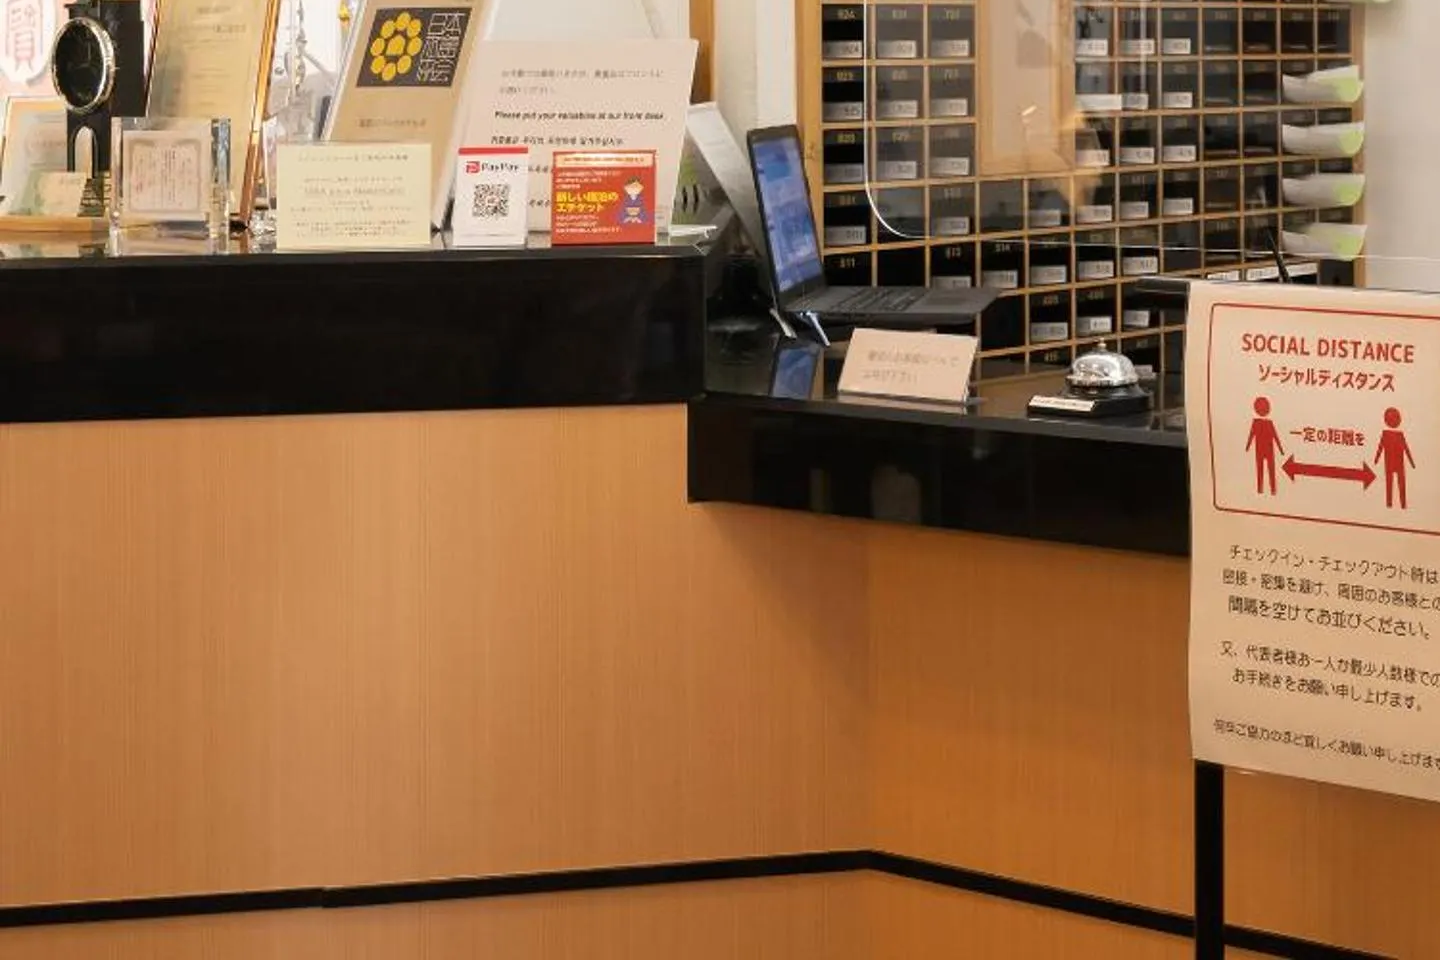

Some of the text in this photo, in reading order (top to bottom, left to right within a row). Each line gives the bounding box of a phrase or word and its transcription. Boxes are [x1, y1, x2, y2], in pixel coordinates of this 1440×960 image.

[481, 161, 520, 174] PayPay
[1241, 333, 1416, 365] SOCIAL DISTANCE
[1257, 363, 1397, 393] ソーシャルディスタンス
[1289, 426, 1367, 448] 一定の距離を
